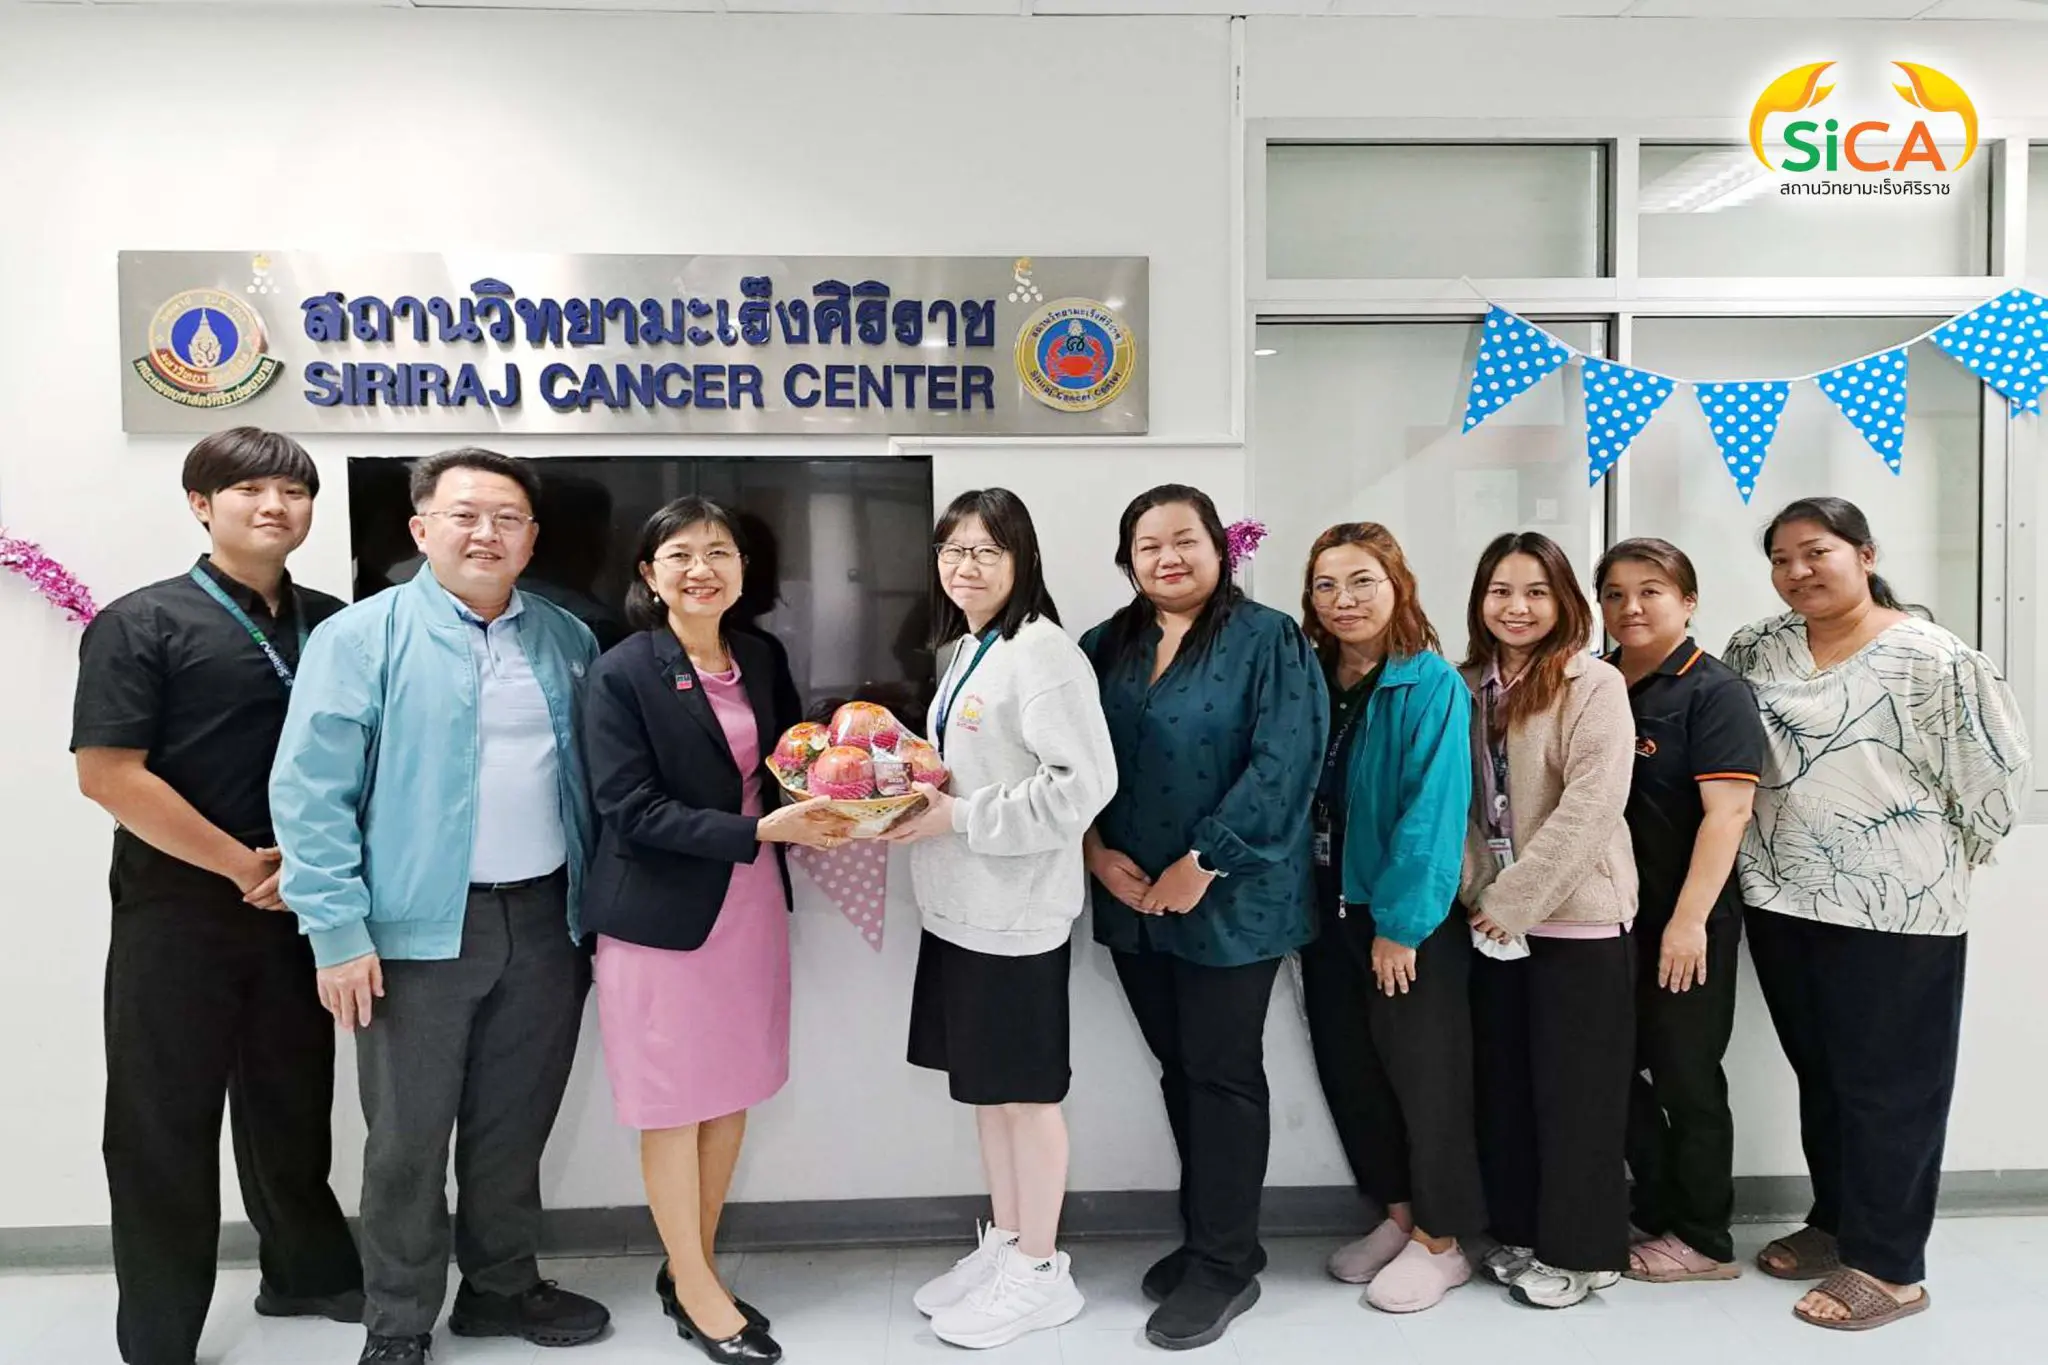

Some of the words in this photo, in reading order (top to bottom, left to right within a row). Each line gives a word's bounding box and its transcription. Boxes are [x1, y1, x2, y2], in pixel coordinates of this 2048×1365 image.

[299, 276, 997, 347] สถานวิทยามะเร็งศิริราช
[304, 361, 522, 408] SIRIRAJ
[540, 362, 765, 410] CANCER
[784, 363, 996, 410] CENTER
